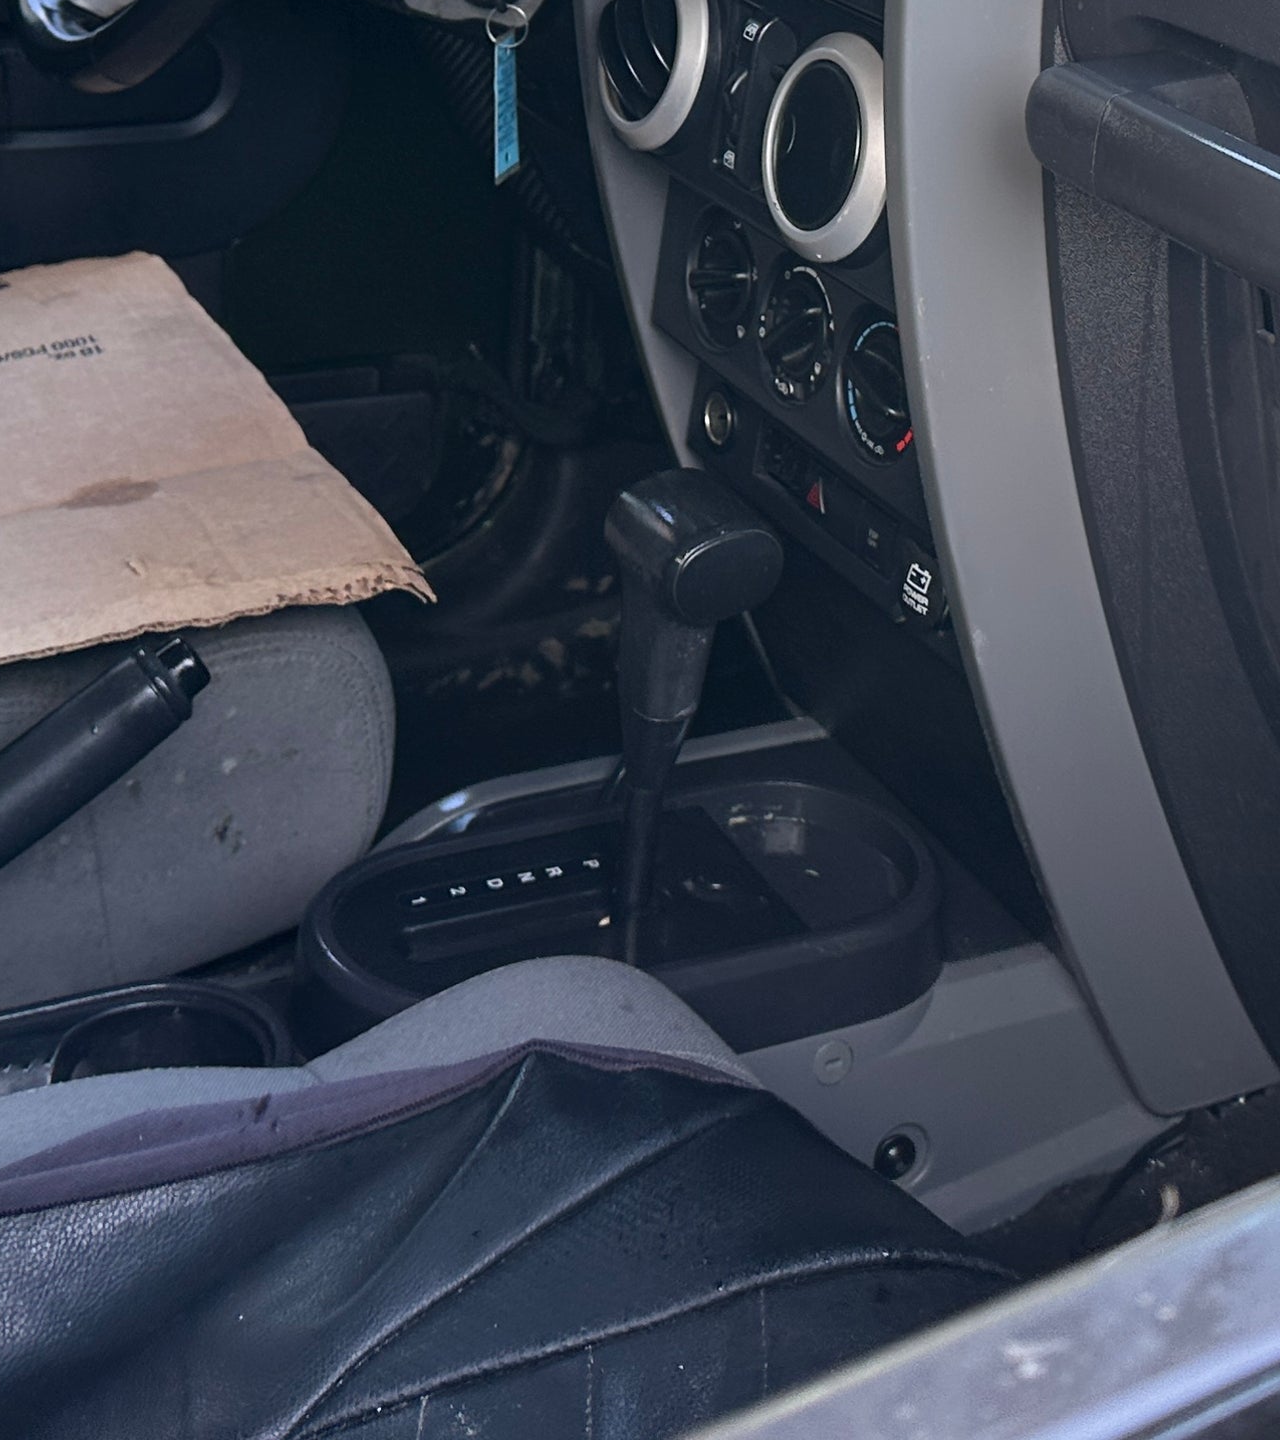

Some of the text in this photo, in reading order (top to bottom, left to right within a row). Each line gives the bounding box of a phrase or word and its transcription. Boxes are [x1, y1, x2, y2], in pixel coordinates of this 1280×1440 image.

[51, 334, 98, 351] 1000
[902, 582, 929, 607] POWER
[411, 859, 600, 906] P R N D 2 1
